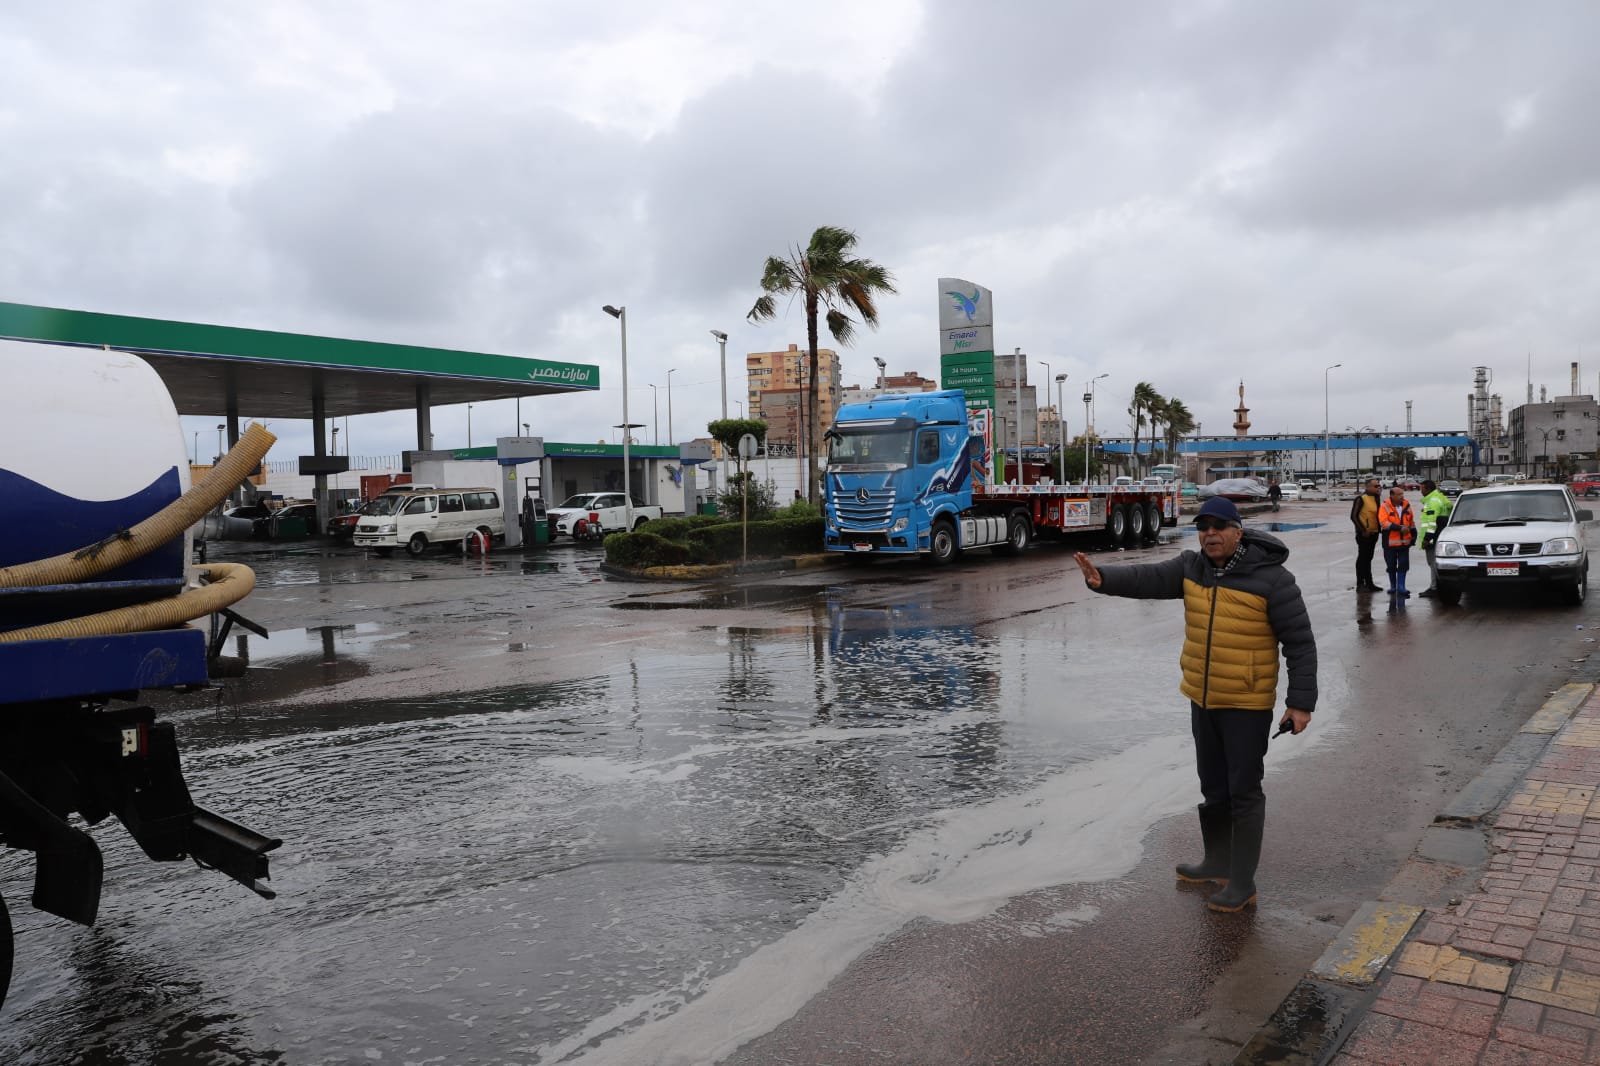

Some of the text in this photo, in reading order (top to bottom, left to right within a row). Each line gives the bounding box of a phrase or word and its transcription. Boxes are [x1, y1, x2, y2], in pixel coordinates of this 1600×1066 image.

[949, 331, 977, 339] Emarat
[953, 340, 972, 350] Misr
[528, 368, 560, 379] مصر
